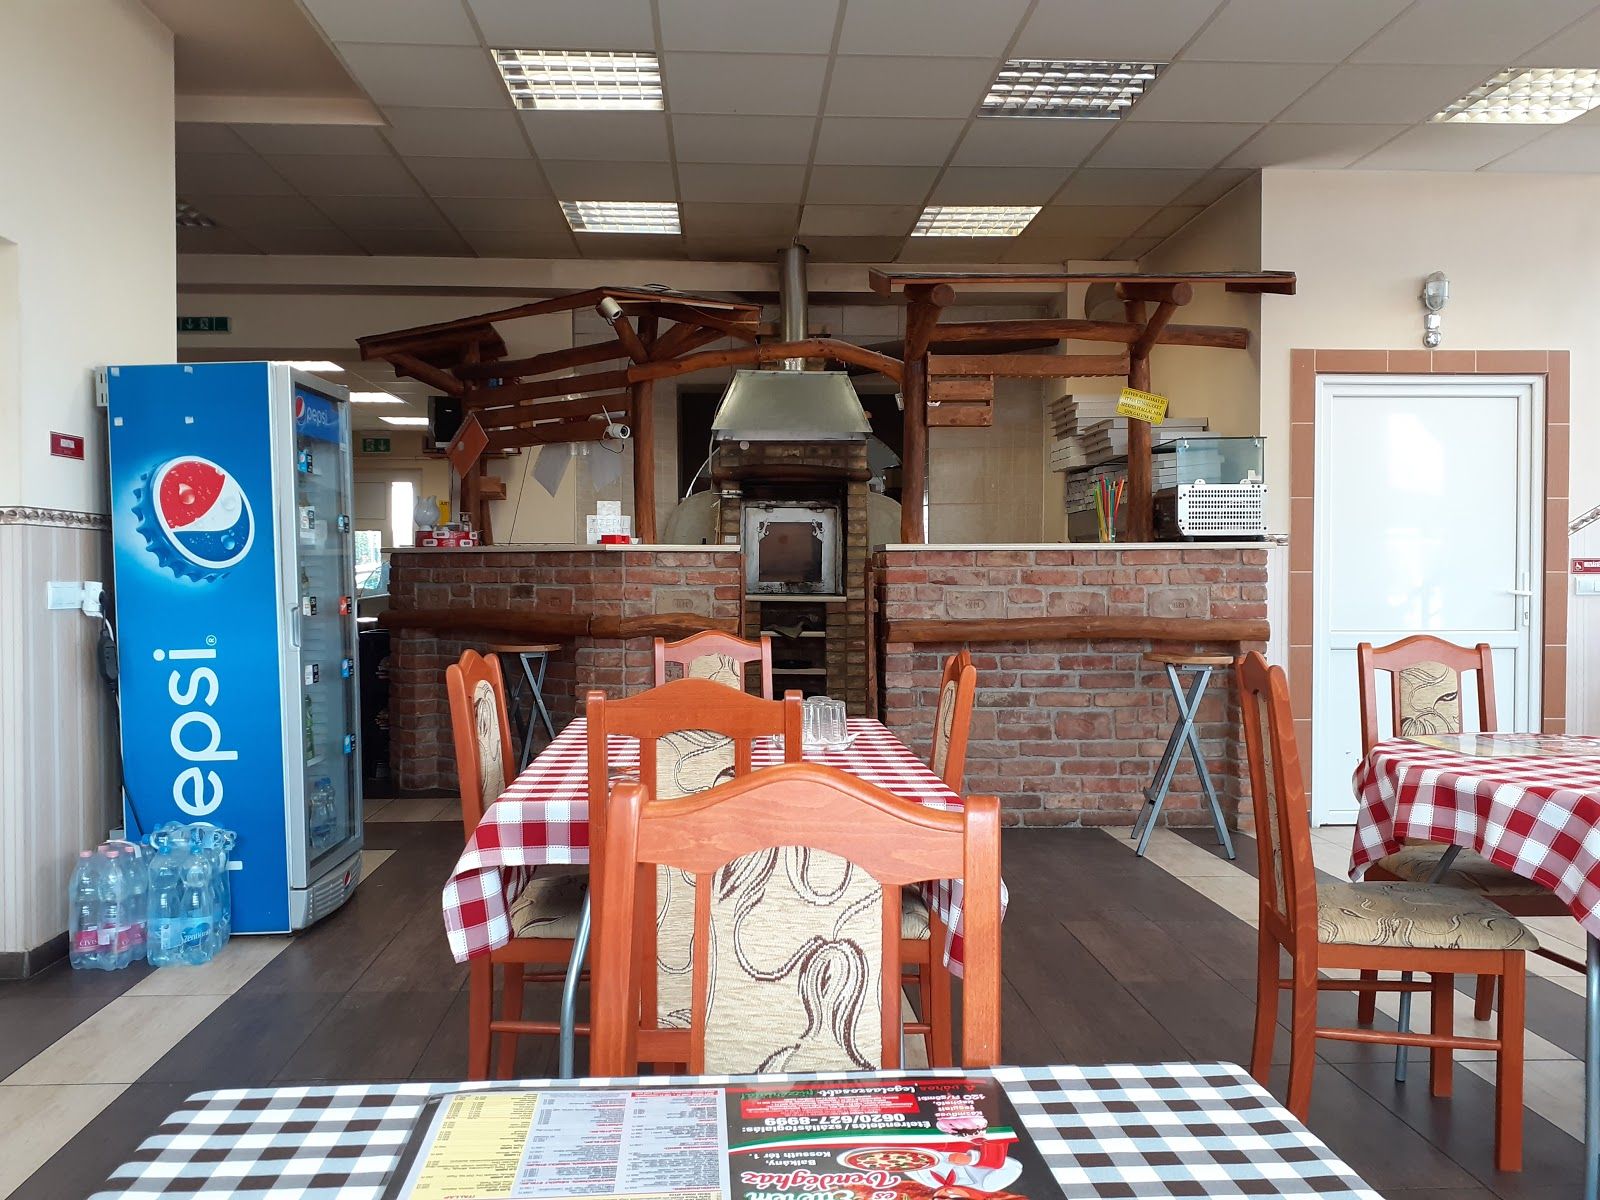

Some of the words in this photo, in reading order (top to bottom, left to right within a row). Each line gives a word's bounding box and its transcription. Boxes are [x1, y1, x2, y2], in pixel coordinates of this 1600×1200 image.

[306, 406, 328, 427] pepsi
[764, 1113, 906, 1126] 0620/627-8999
[740, 1169, 901, 1192] Vendégház
